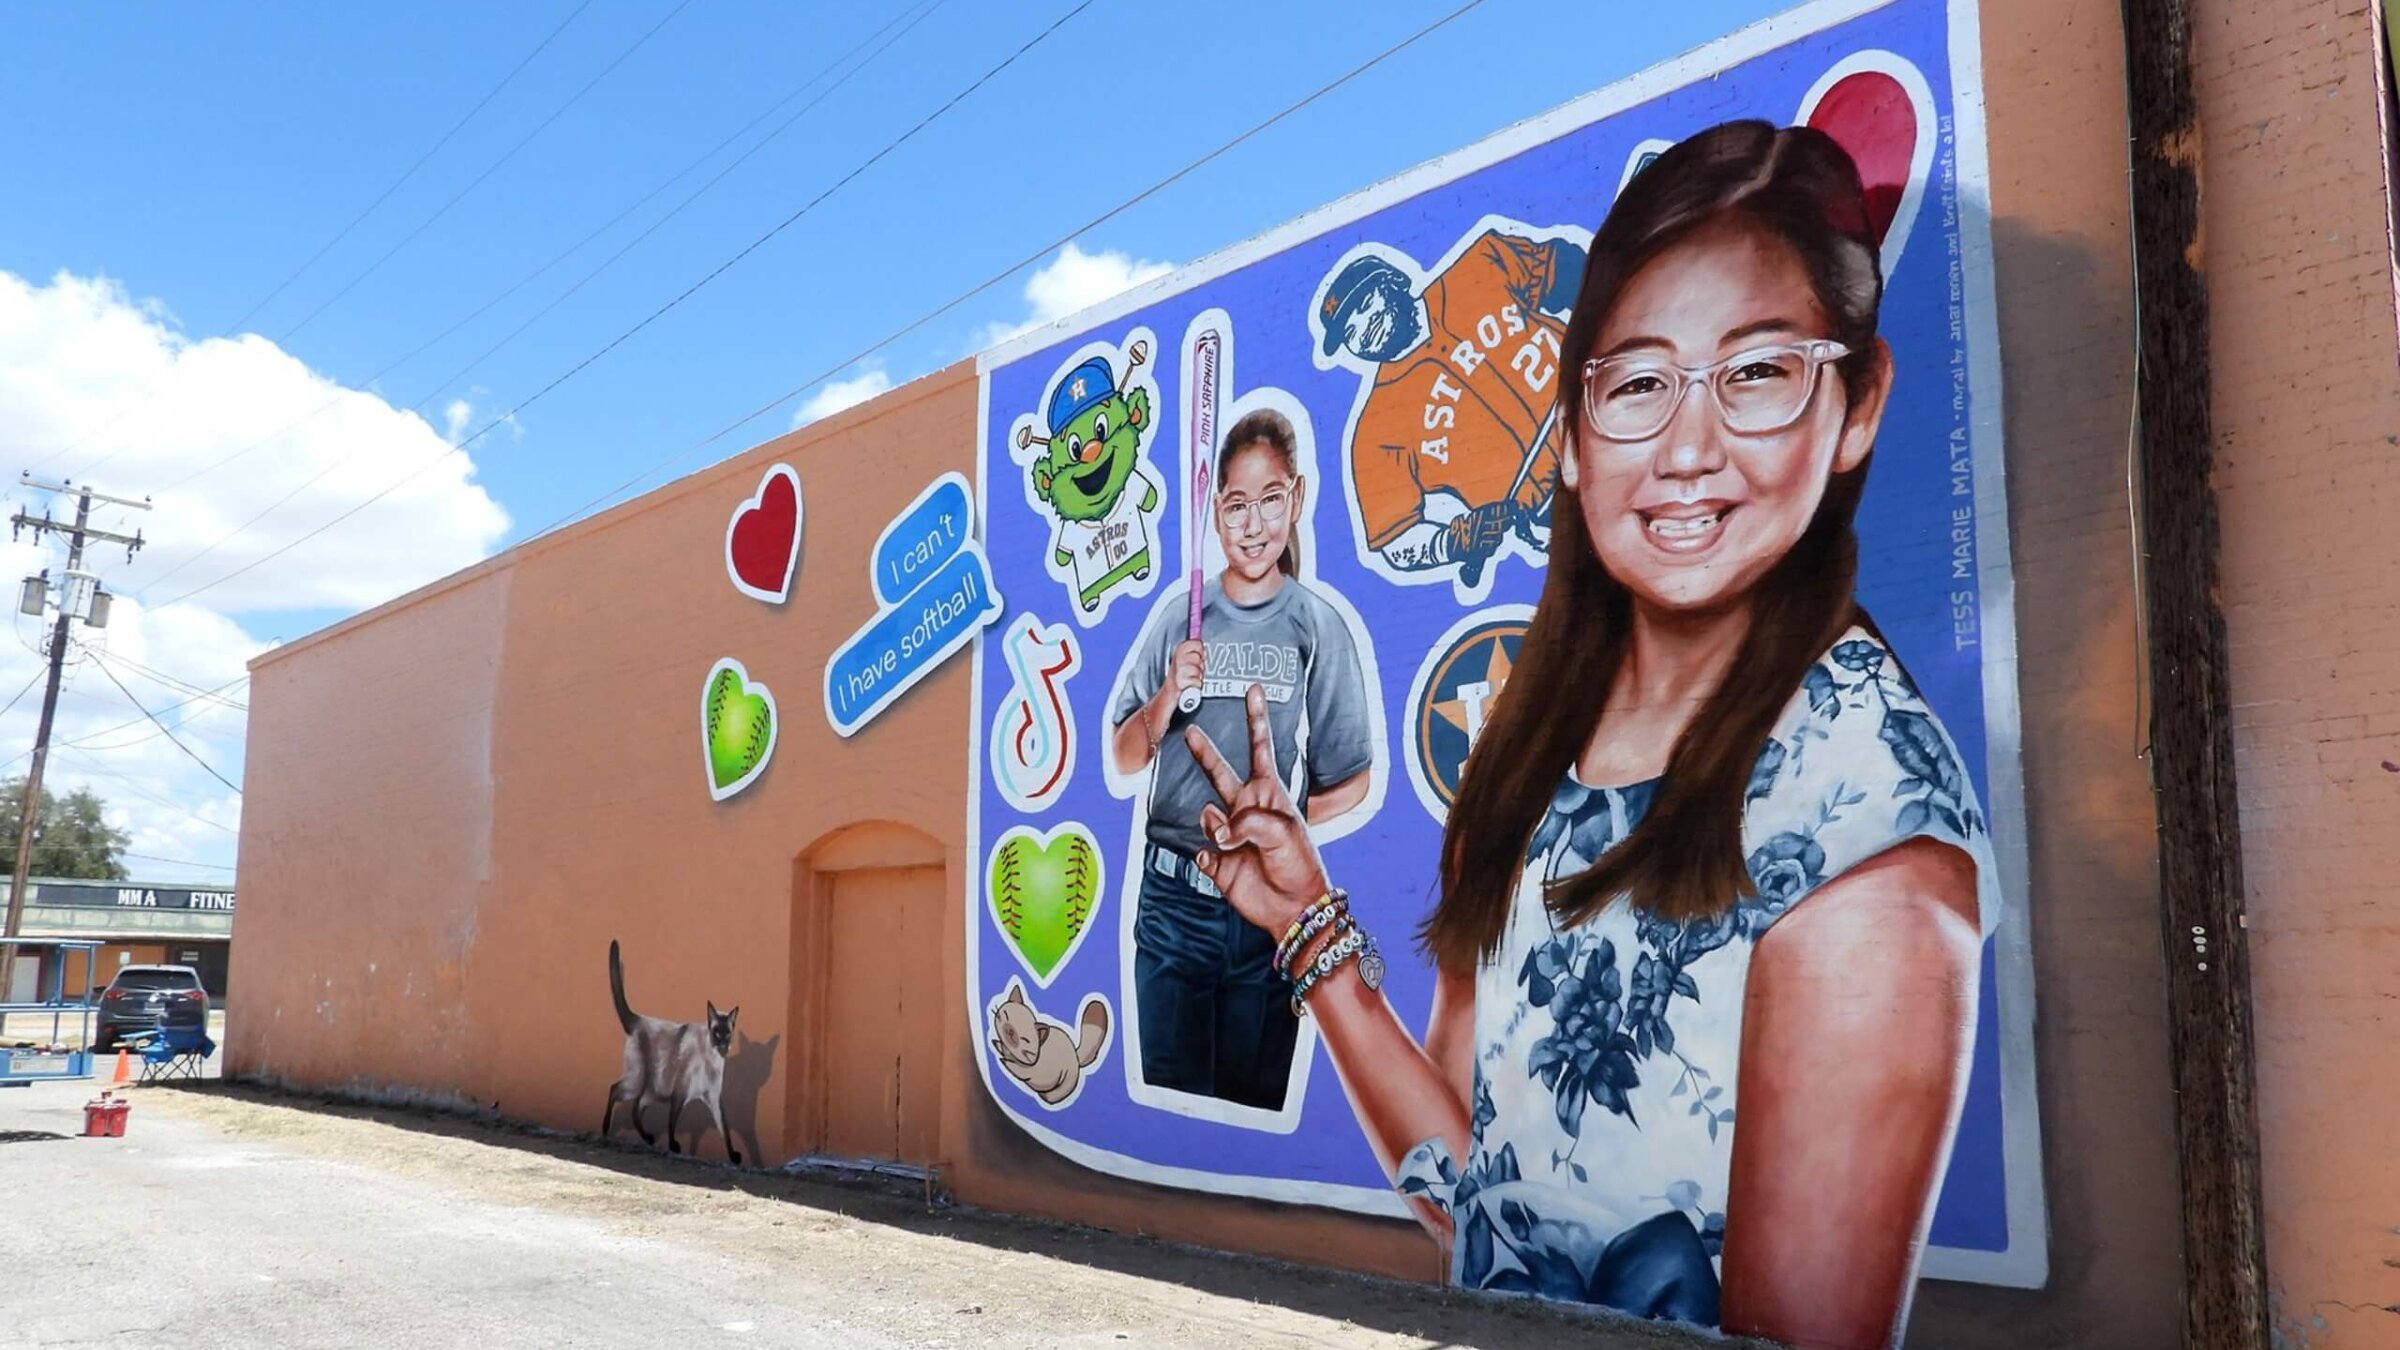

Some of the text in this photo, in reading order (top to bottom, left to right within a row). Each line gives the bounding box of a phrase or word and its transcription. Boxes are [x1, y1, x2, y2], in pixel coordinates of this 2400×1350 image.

[1421, 302, 1529, 466] ASTROS
[1511, 325, 1562, 394] 27
[1949, 348, 1964, 364] by
[1951, 368, 1966, 410] mural
[1949, 427, 1971, 495] MATA
[889, 513, 957, 586] I can't
[1085, 521, 1130, 560] ASTROS
[1950, 506, 1973, 578] MARIE
[837, 571, 977, 713] I have softball
[1951, 590, 1977, 651] TESS
[1205, 641, 1299, 683] VALDE
[1205, 681, 1232, 694] TTLE
[117, 888, 235, 910] MMA FITNE
